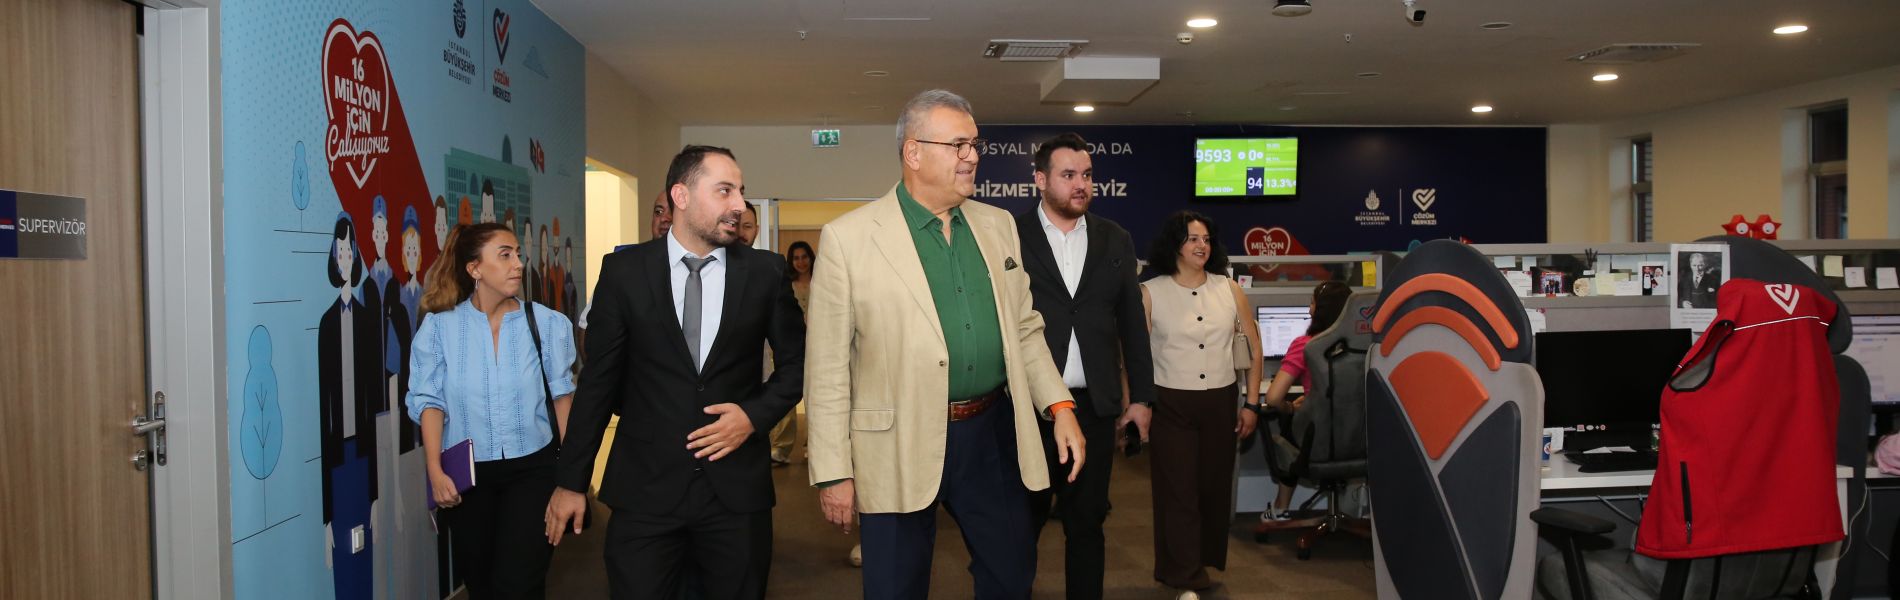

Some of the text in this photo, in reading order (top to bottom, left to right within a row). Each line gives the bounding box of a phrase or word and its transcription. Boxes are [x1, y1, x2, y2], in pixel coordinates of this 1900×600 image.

[351, 57, 365, 82] 16
[328, 124, 390, 172] Çalışıyoruz
[1111, 142, 1133, 155] DA
[1195, 148, 1232, 163] 9593
[1247, 177, 1263, 189] 94
[18, 217, 86, 235] SUPERVİZÖR
